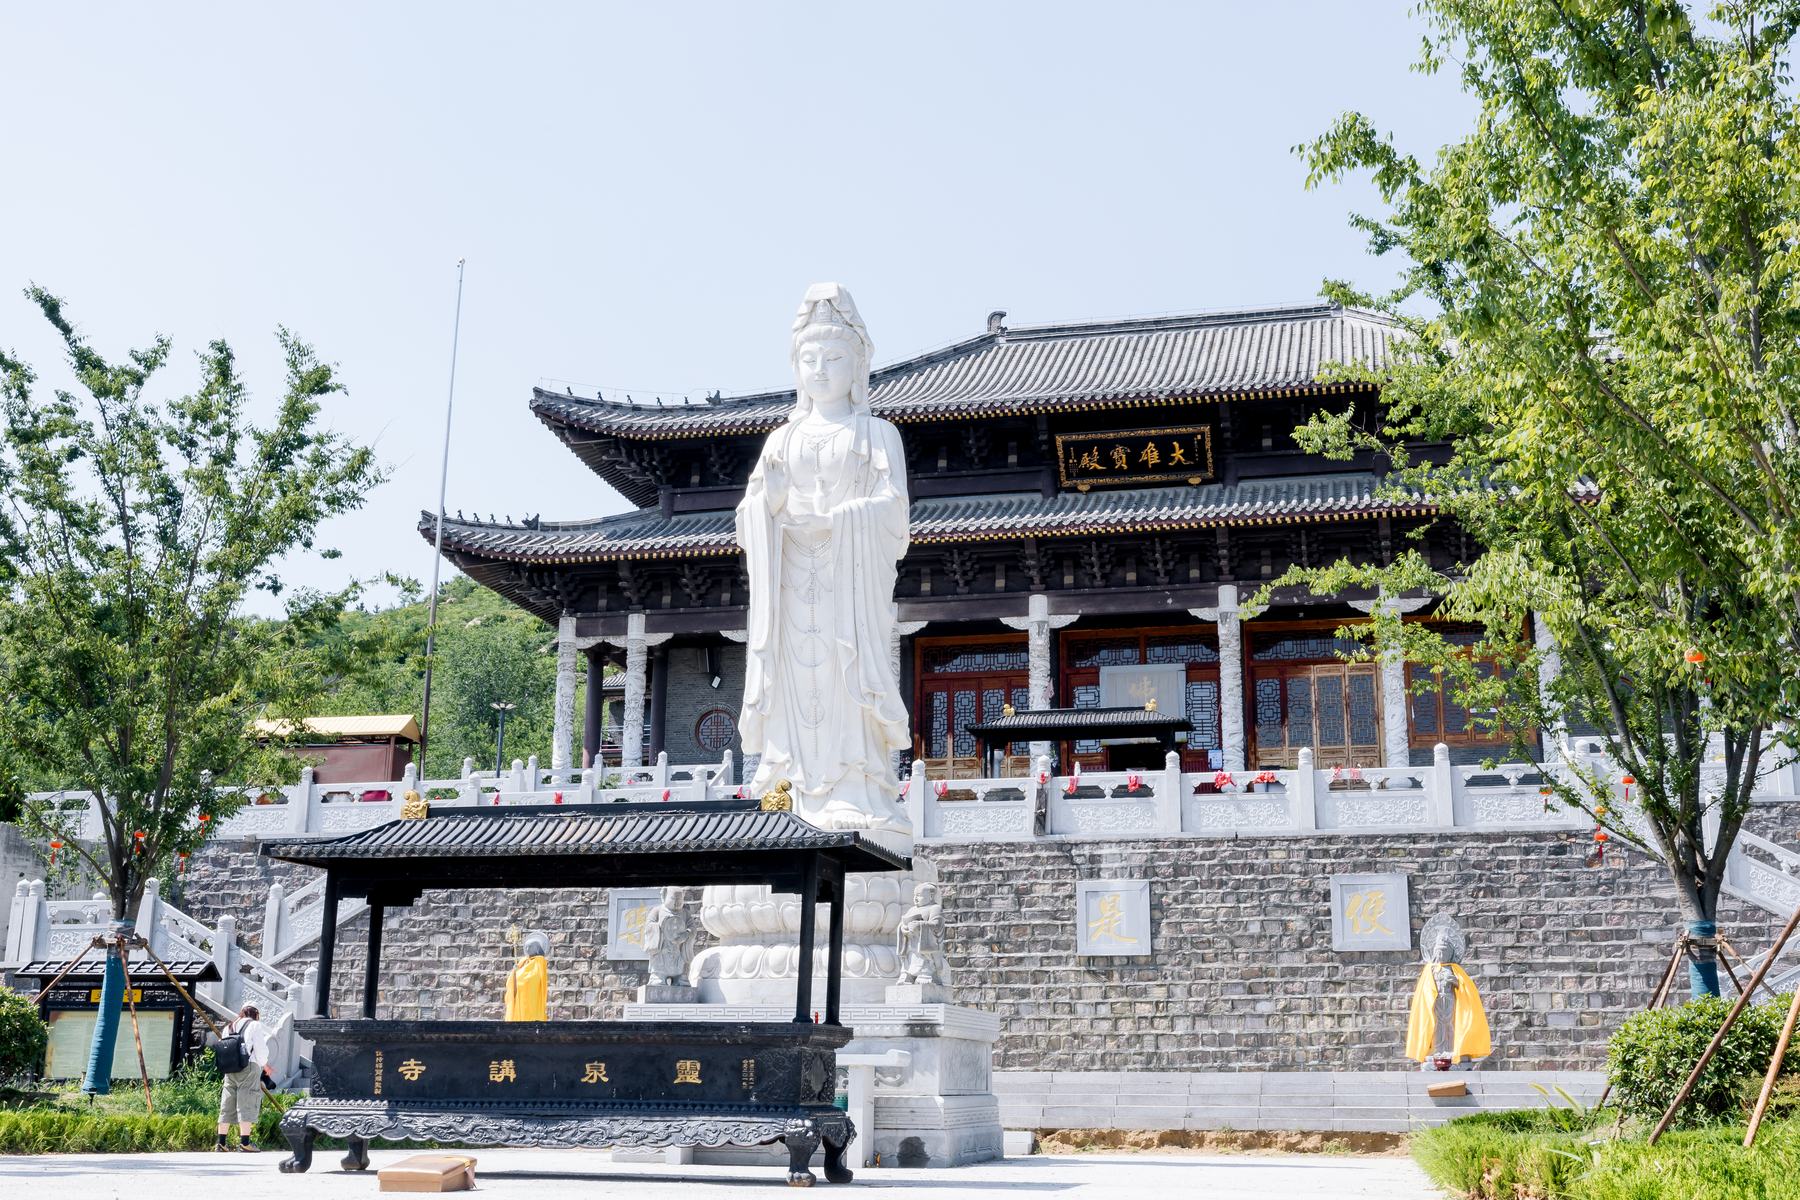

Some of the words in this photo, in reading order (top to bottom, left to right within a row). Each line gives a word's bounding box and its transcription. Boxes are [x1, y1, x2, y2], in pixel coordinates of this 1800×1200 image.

[1079, 441, 1194, 470] 大雄寶殿
[1088, 893, 1137, 944] 是
[398, 1058, 702, 1085] 靈泉講寺
